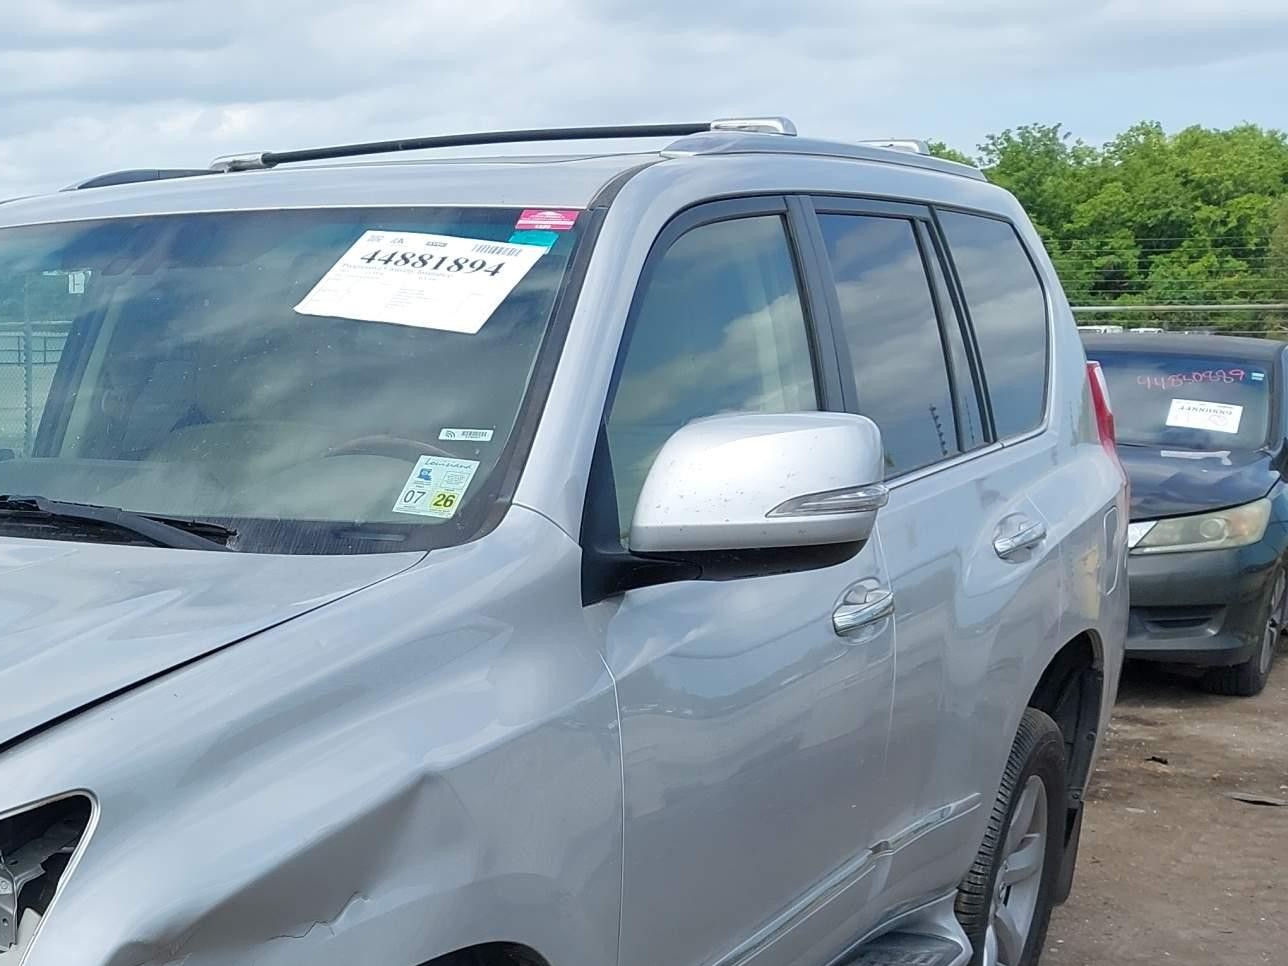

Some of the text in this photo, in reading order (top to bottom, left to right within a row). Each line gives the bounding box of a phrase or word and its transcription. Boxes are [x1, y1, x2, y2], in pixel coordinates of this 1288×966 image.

[360, 249, 506, 277] 44881894
[403, 489, 456, 508] 07 26
